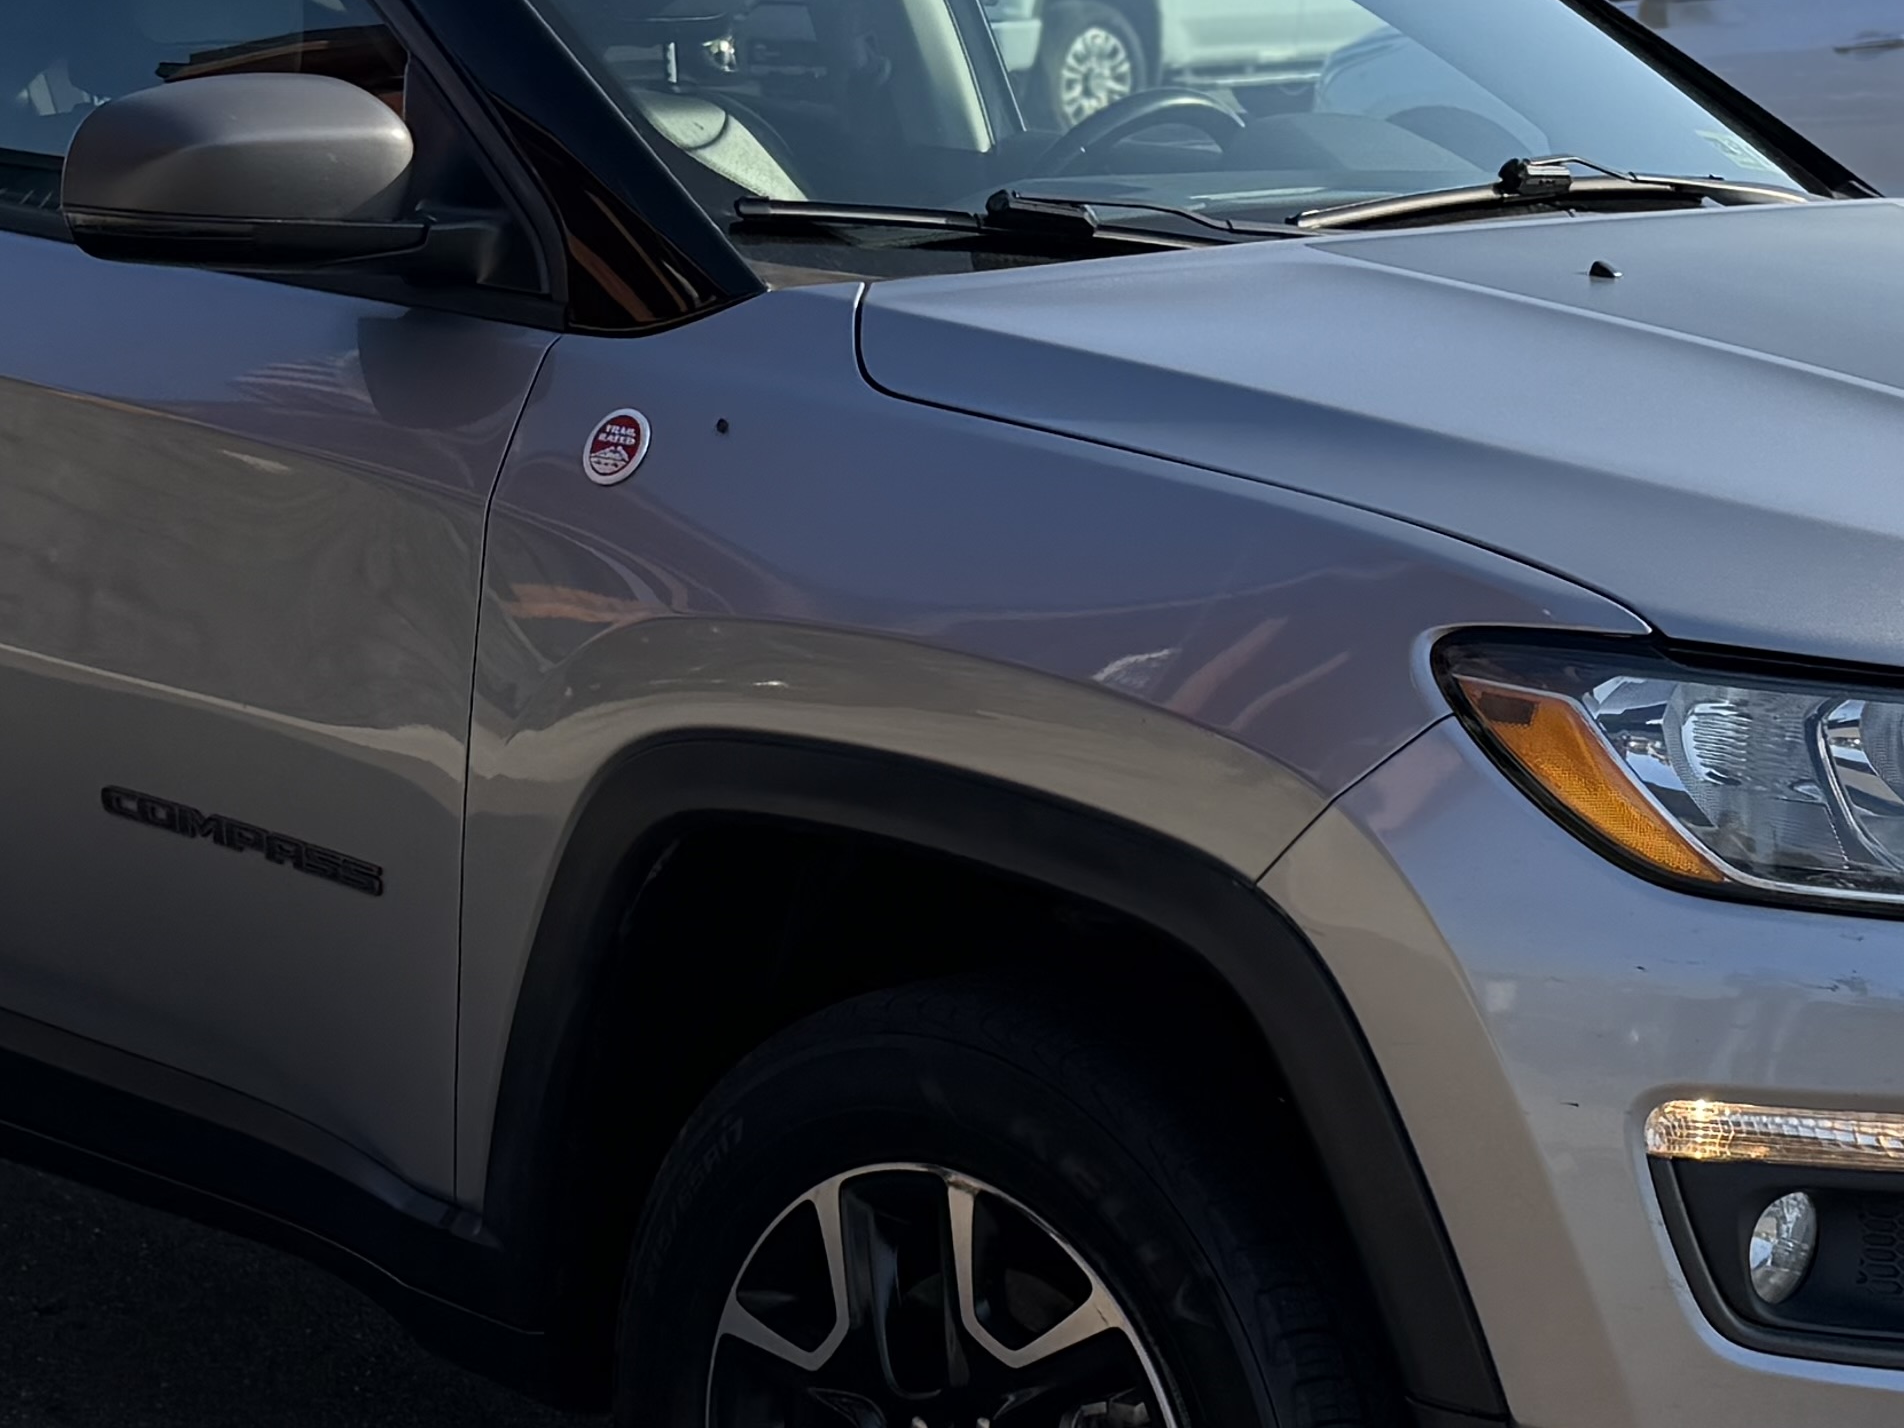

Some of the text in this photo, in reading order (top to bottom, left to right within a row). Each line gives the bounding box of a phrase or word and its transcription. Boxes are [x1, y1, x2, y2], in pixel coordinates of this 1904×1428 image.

[606, 424, 637, 437] TRAIL
[598, 433, 637, 445] RATED
[100, 784, 385, 898] COMPASS
